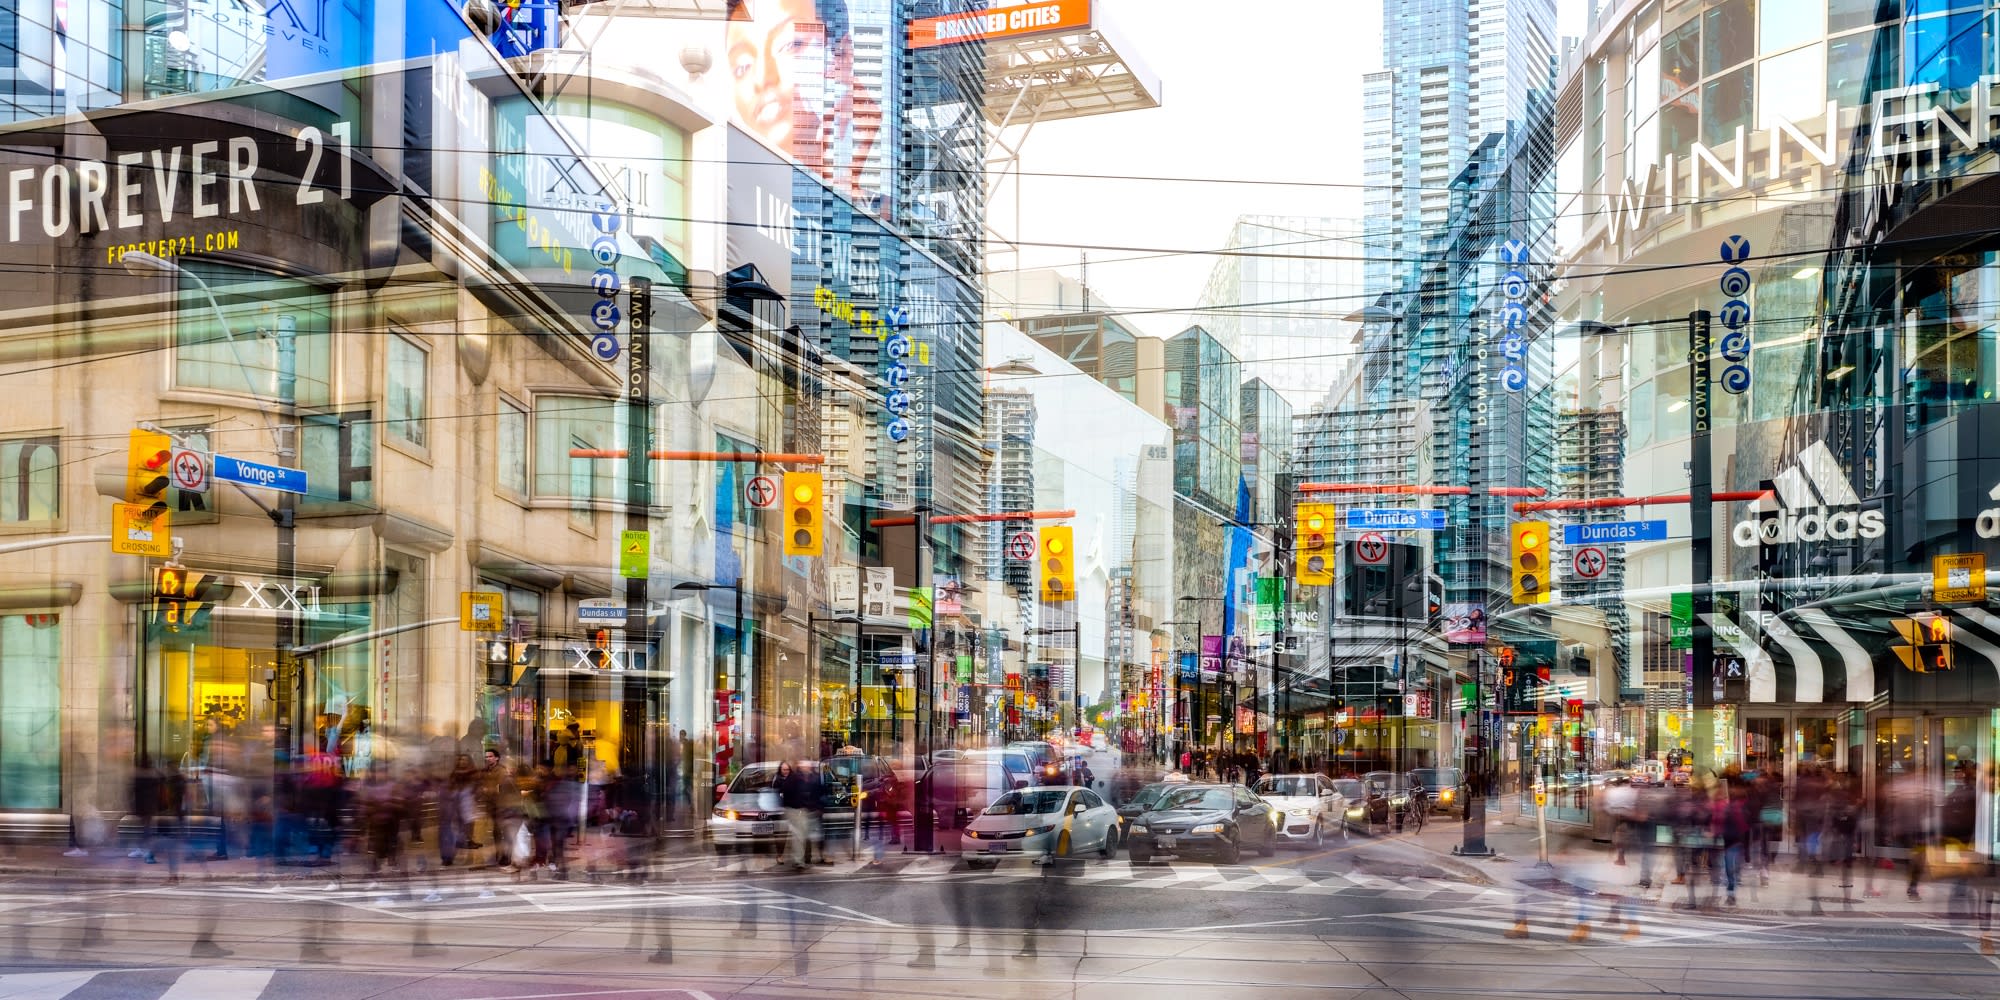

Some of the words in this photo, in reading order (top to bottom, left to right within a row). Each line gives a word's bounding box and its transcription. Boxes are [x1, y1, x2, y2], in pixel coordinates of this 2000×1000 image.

[189, 9, 329, 57] FOREVER
[936, 13, 1007, 40] BRANDED
[1010, 5, 1060, 30] CITIES
[9, 136, 262, 244] FOREVER
[296, 121, 353, 206] 21
[756, 185, 801, 257] LIKE
[630, 287, 642, 398] DOWNTOWN
[1477, 319, 1487, 426] DOWNTOWN
[1695, 320, 1707, 431] DOWNTOWN
[916, 376, 925, 471] DOWNTOWN
[236, 461, 276, 484] Yonge
[278, 470, 286, 479] St
[123, 507, 160, 517] PRIORITY
[1364, 512, 1417, 526] Dundas
[1421, 511, 1429, 519] St
[1733, 509, 1886, 547] adidas
[1582, 525, 1636, 539] Dundas
[1642, 522, 1649, 531] St
[121, 542, 161, 553] CROSSING
[1943, 557, 1974, 566] PRIORITY
[240, 580, 322, 613] XXI
[1941, 590, 1977, 599] CROSSING
[581, 609, 608, 617] Dundas
[617, 609, 623, 617] W
[571, 647, 637, 669] XXI
